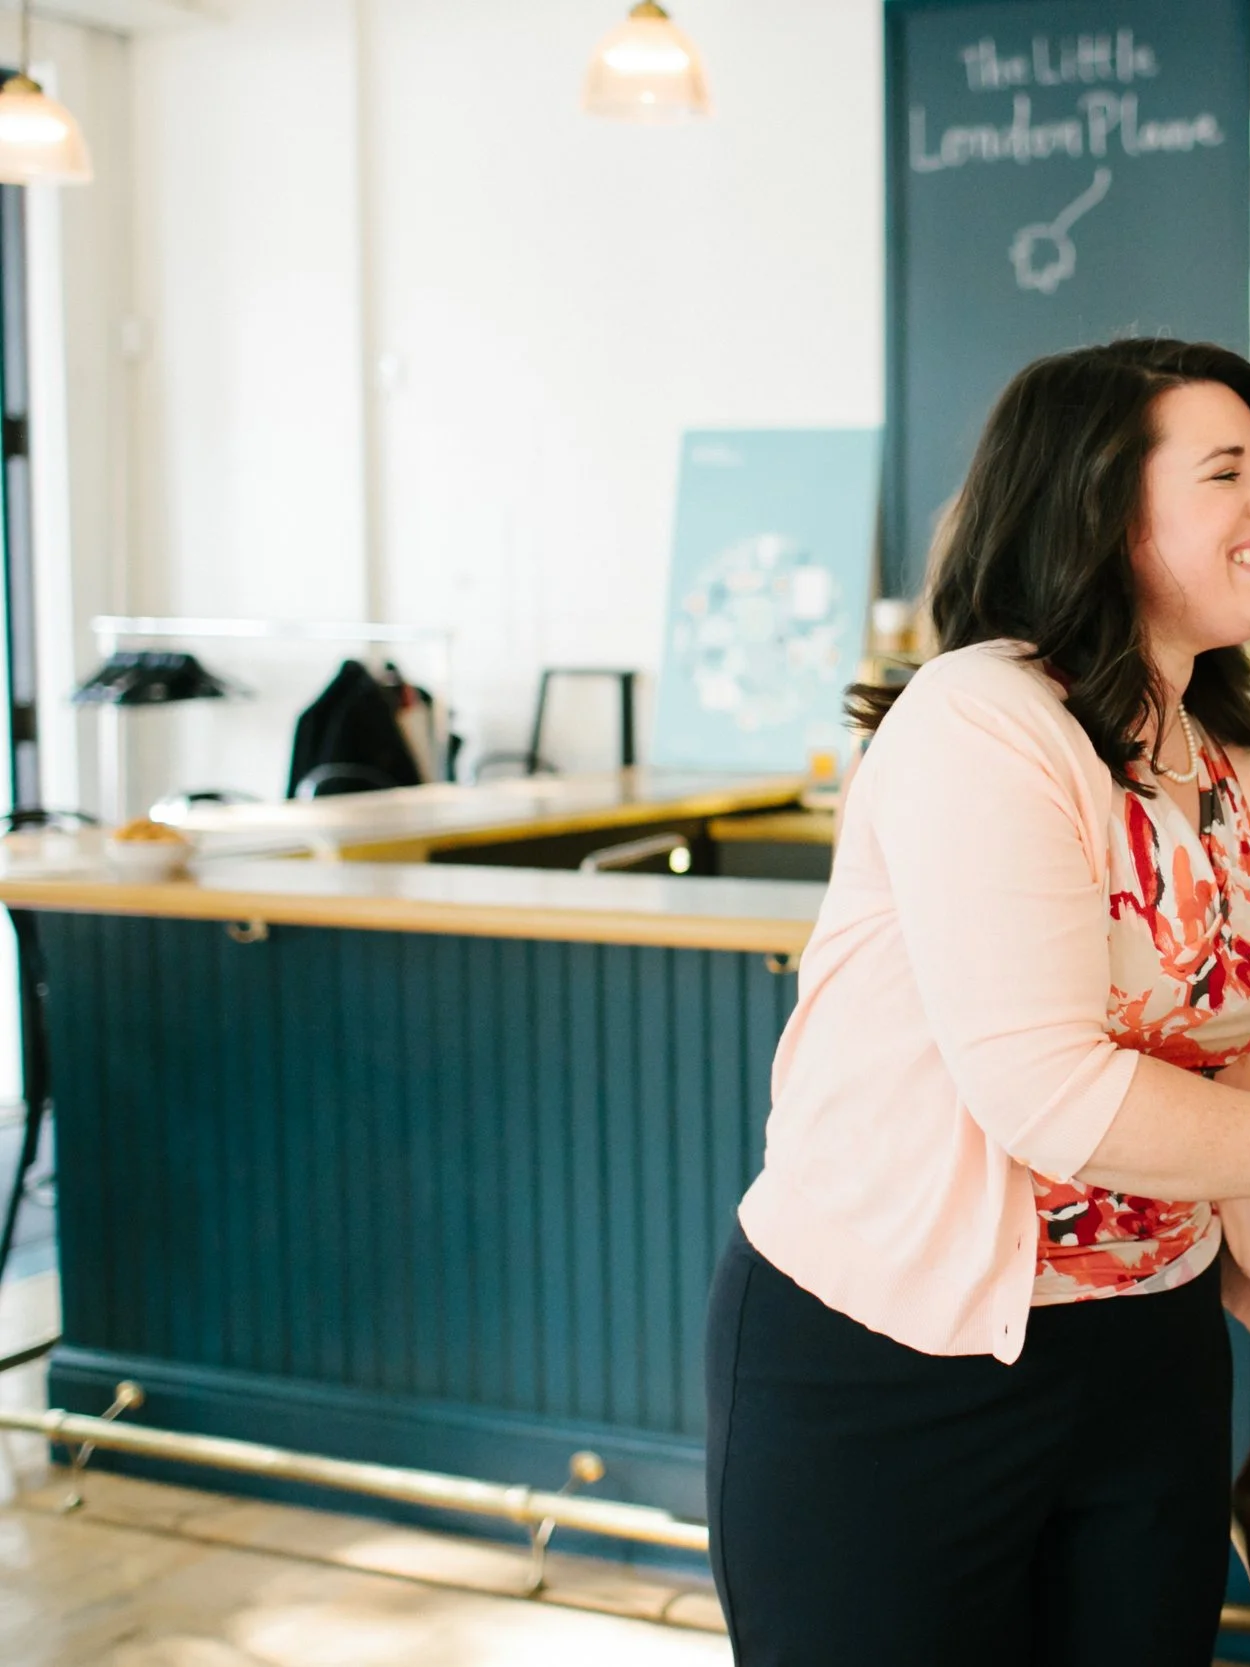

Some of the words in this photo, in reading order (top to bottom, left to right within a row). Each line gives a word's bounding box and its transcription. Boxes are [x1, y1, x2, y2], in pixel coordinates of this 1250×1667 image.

[962, 33, 1030, 91] The
[1031, 27, 1160, 87] Little
[909, 94, 1083, 173] London
